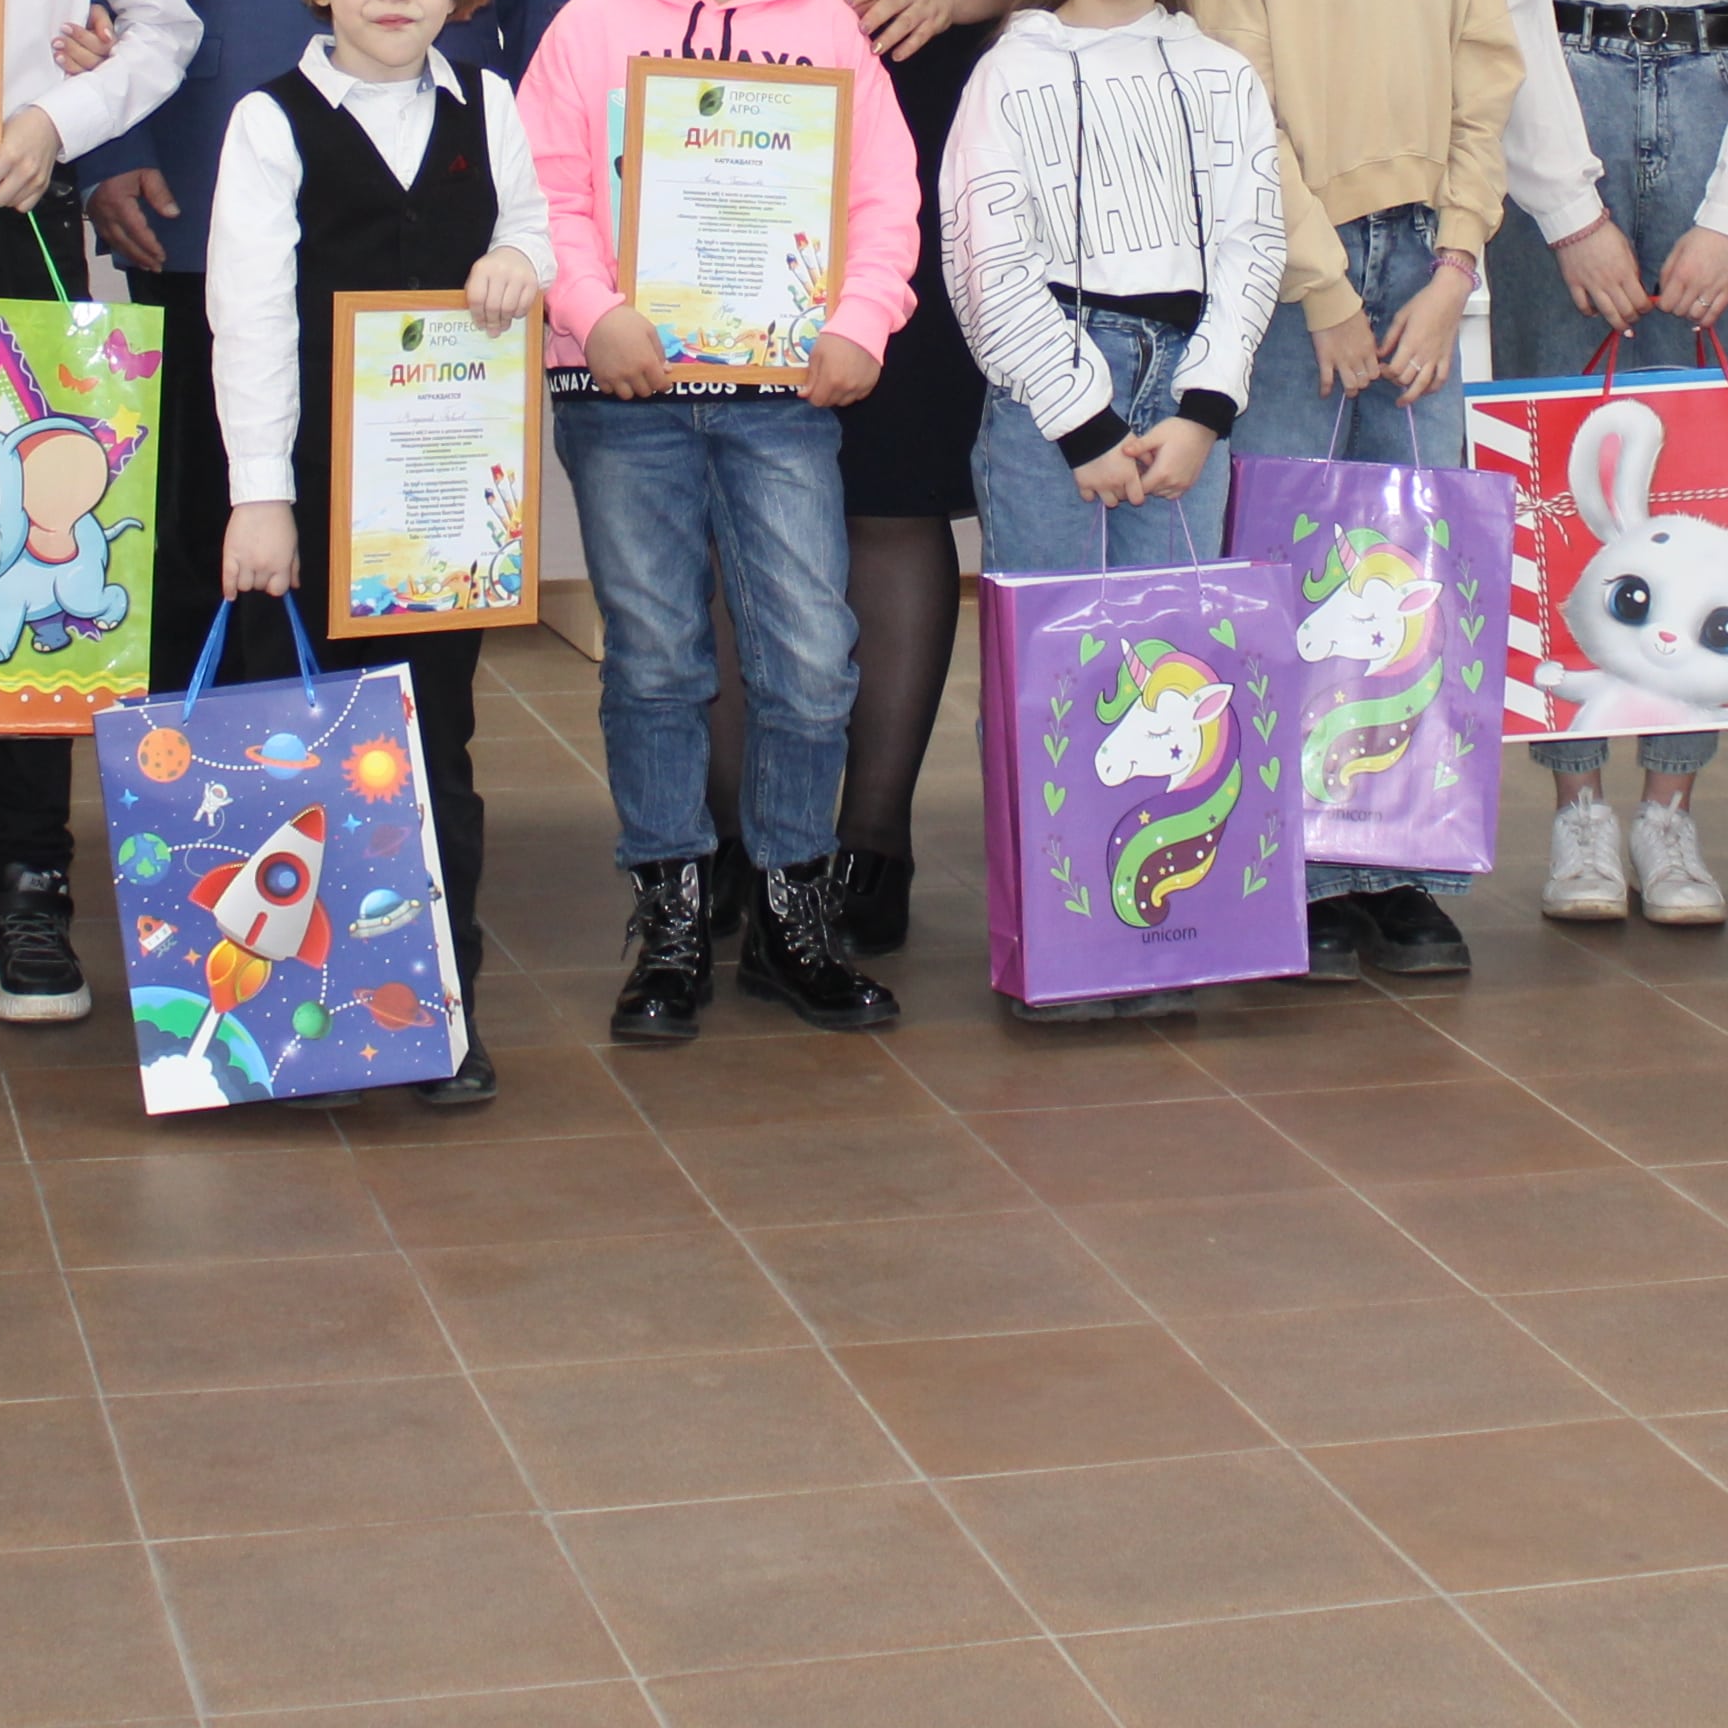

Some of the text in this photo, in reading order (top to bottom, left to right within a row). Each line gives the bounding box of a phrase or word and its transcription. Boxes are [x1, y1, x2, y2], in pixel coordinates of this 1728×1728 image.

[729, 89, 792, 106] ПРОГРЕСС
[729, 103, 760, 116] АГРО
[684, 127, 792, 151] ДИПЛОМ
[429, 320, 484, 335] ПРОГРЕС
[429, 335, 458, 348] АГРО
[389, 360, 486, 387] ДИПЛОМ
[1140, 925, 1198, 945] unicorn
